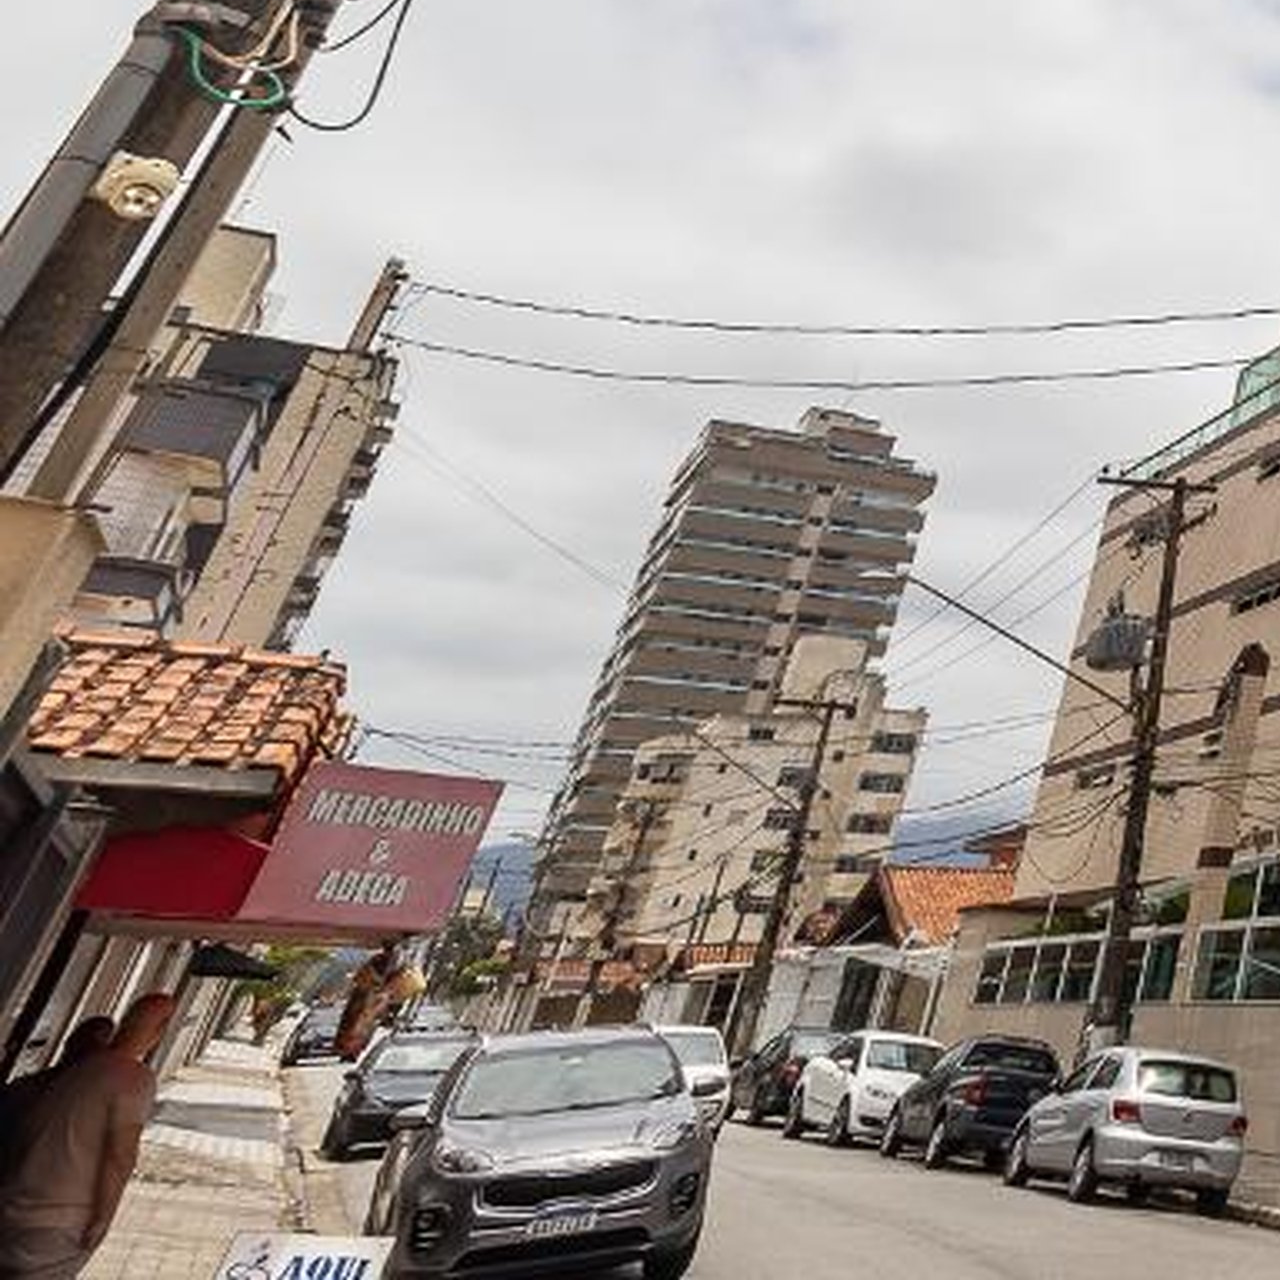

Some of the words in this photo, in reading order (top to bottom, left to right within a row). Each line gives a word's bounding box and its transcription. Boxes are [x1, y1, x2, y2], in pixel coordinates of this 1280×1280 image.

[310, 789, 485, 835] MERCADINHO
[370, 839, 391, 864] &
[315, 870, 408, 905] ADEGA
